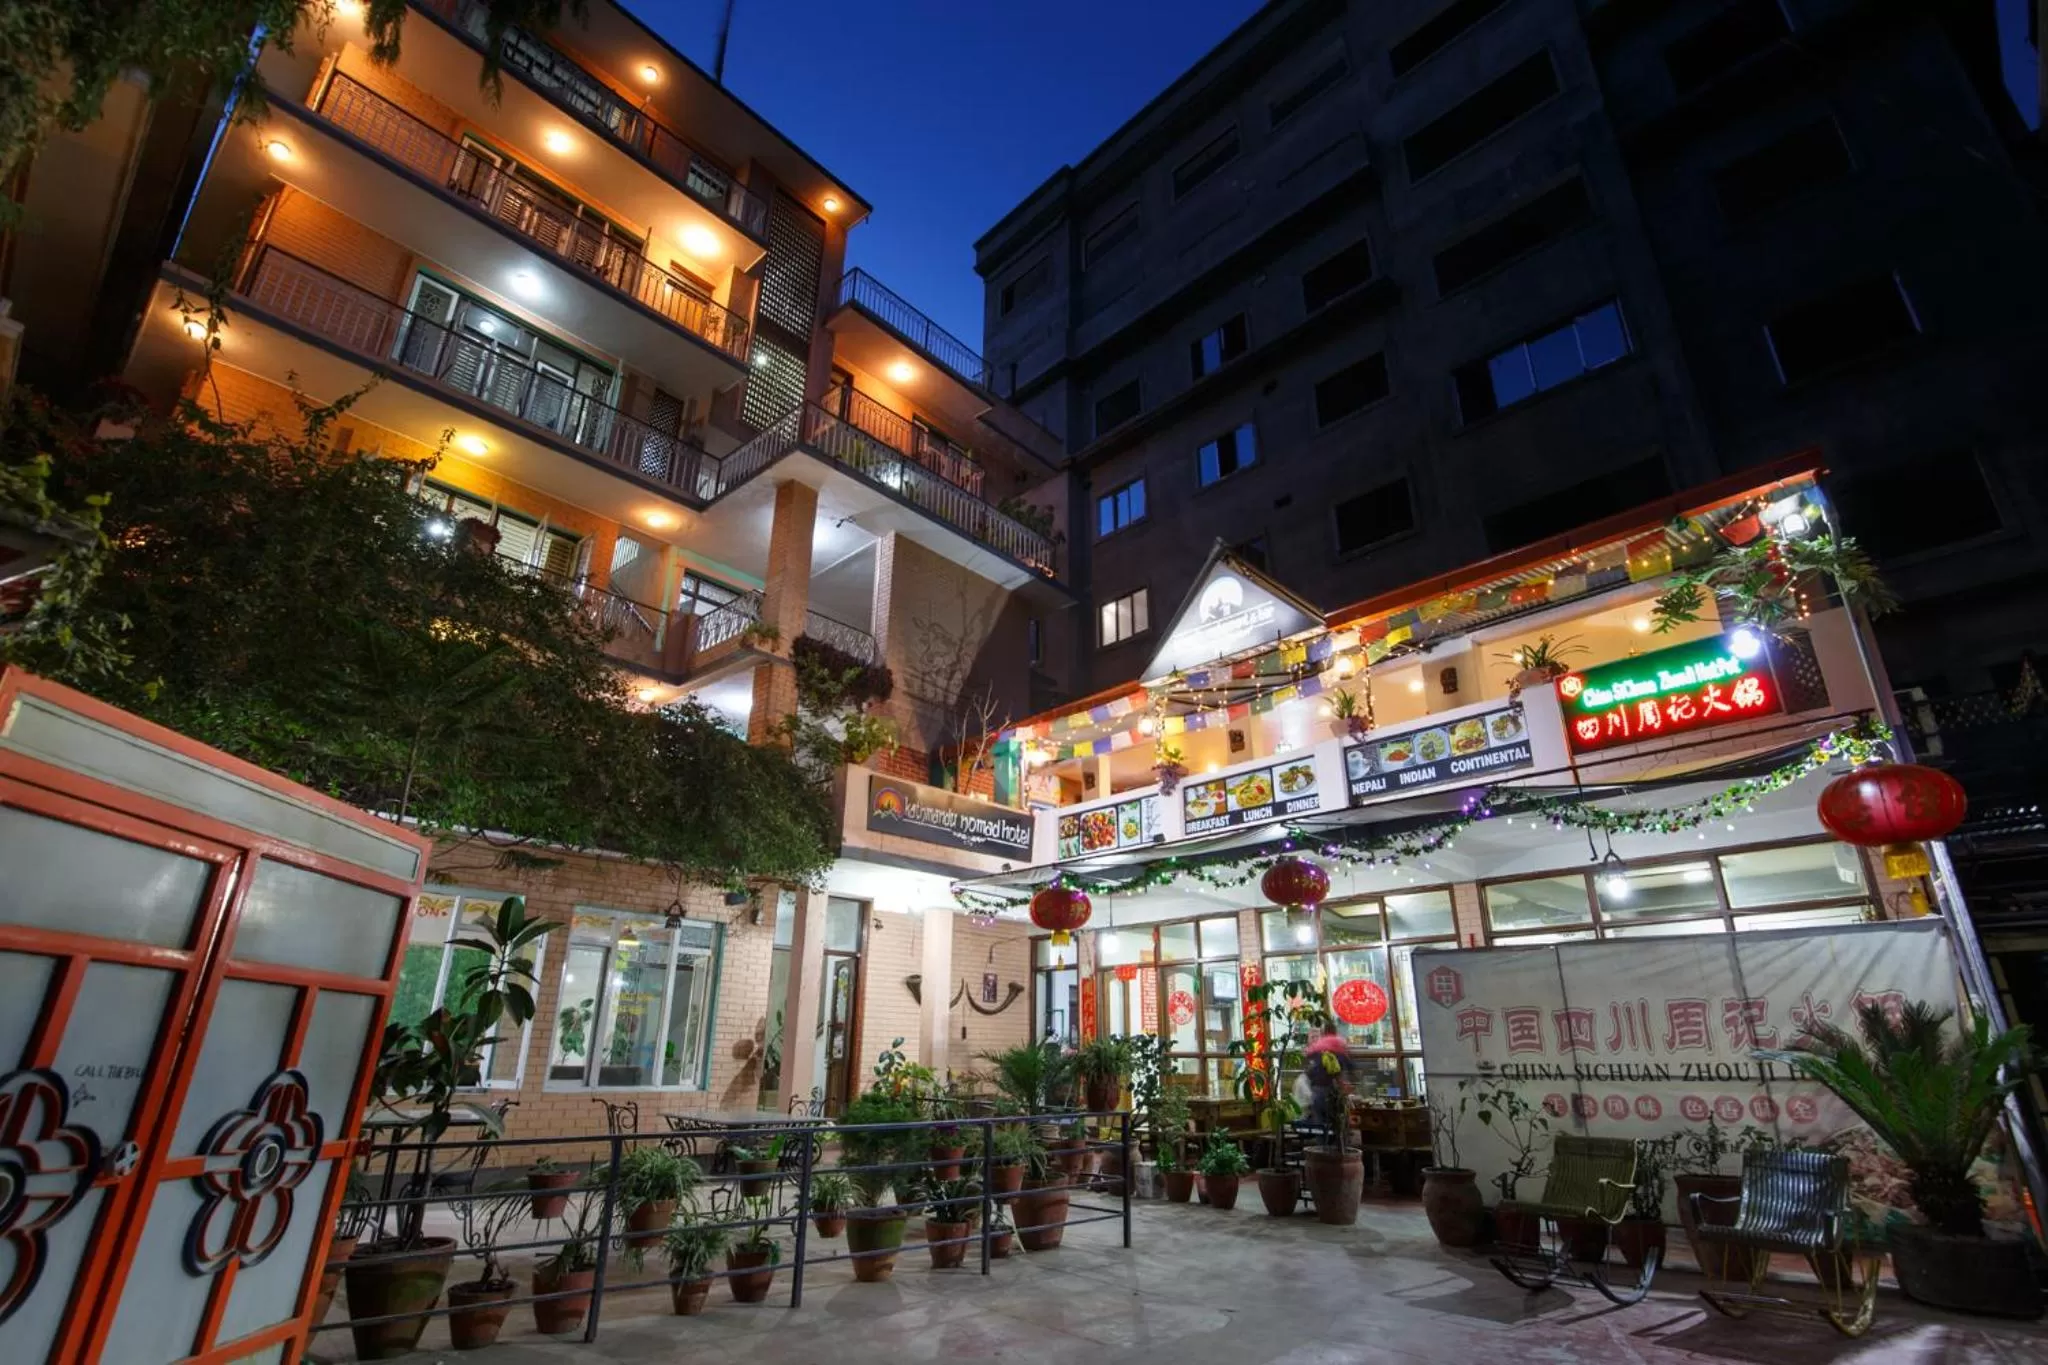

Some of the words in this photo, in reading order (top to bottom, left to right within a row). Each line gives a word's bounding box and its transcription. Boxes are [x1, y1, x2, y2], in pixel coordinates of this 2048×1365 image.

[1576, 676, 1765, 740] 四川周记火锅
[1352, 778, 1386, 795] NEPALI
[1400, 767, 1436, 784] INDIAN
[1450, 746, 1531, 774] CONTINENTAL
[960, 813, 1001, 838] nomad
[1001, 819, 1030, 845] hotel
[1186, 815, 1230, 833] BREAKFAST
[1243, 806, 1273, 822] LUNCH
[1286, 797, 1320, 813] DINNER
[74, 1064, 104, 1077] CALL
[1500, 1063, 1566, 1081] CHINA
[1574, 1063, 1671, 1082] SICHUAN
[1679, 1062, 1750, 1082] ZHOU
[1756, 1062, 1776, 1086] JI
